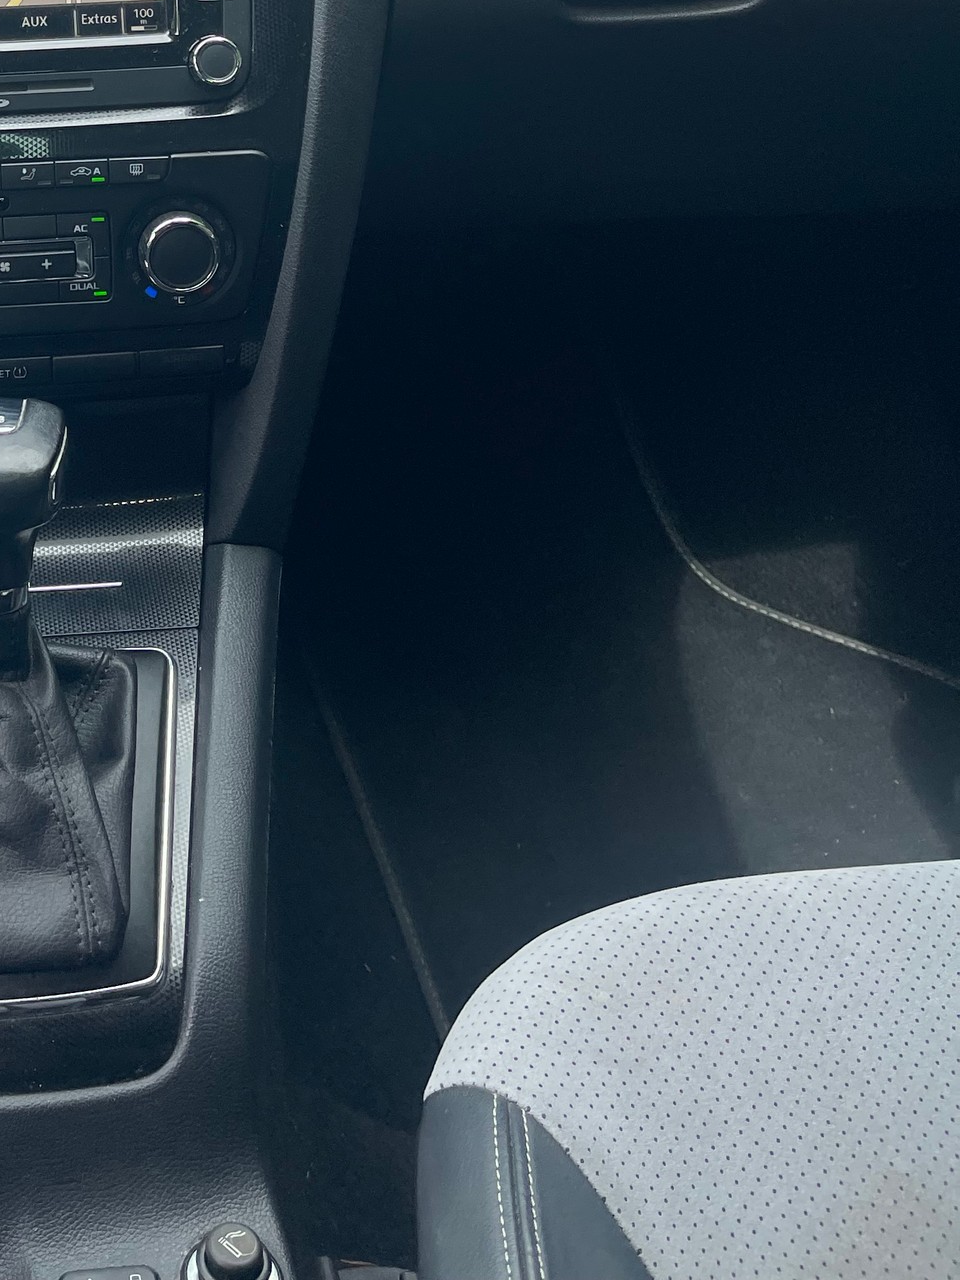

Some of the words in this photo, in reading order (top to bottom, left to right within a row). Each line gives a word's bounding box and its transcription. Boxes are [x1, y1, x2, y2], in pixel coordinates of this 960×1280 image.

[133, 7, 154, 18] 100
[21, 16, 48, 28] AUX
[81, 13, 118, 25] Extras
[73, 224, 88, 233] AC
[69, 281, 100, 291] DUAL
